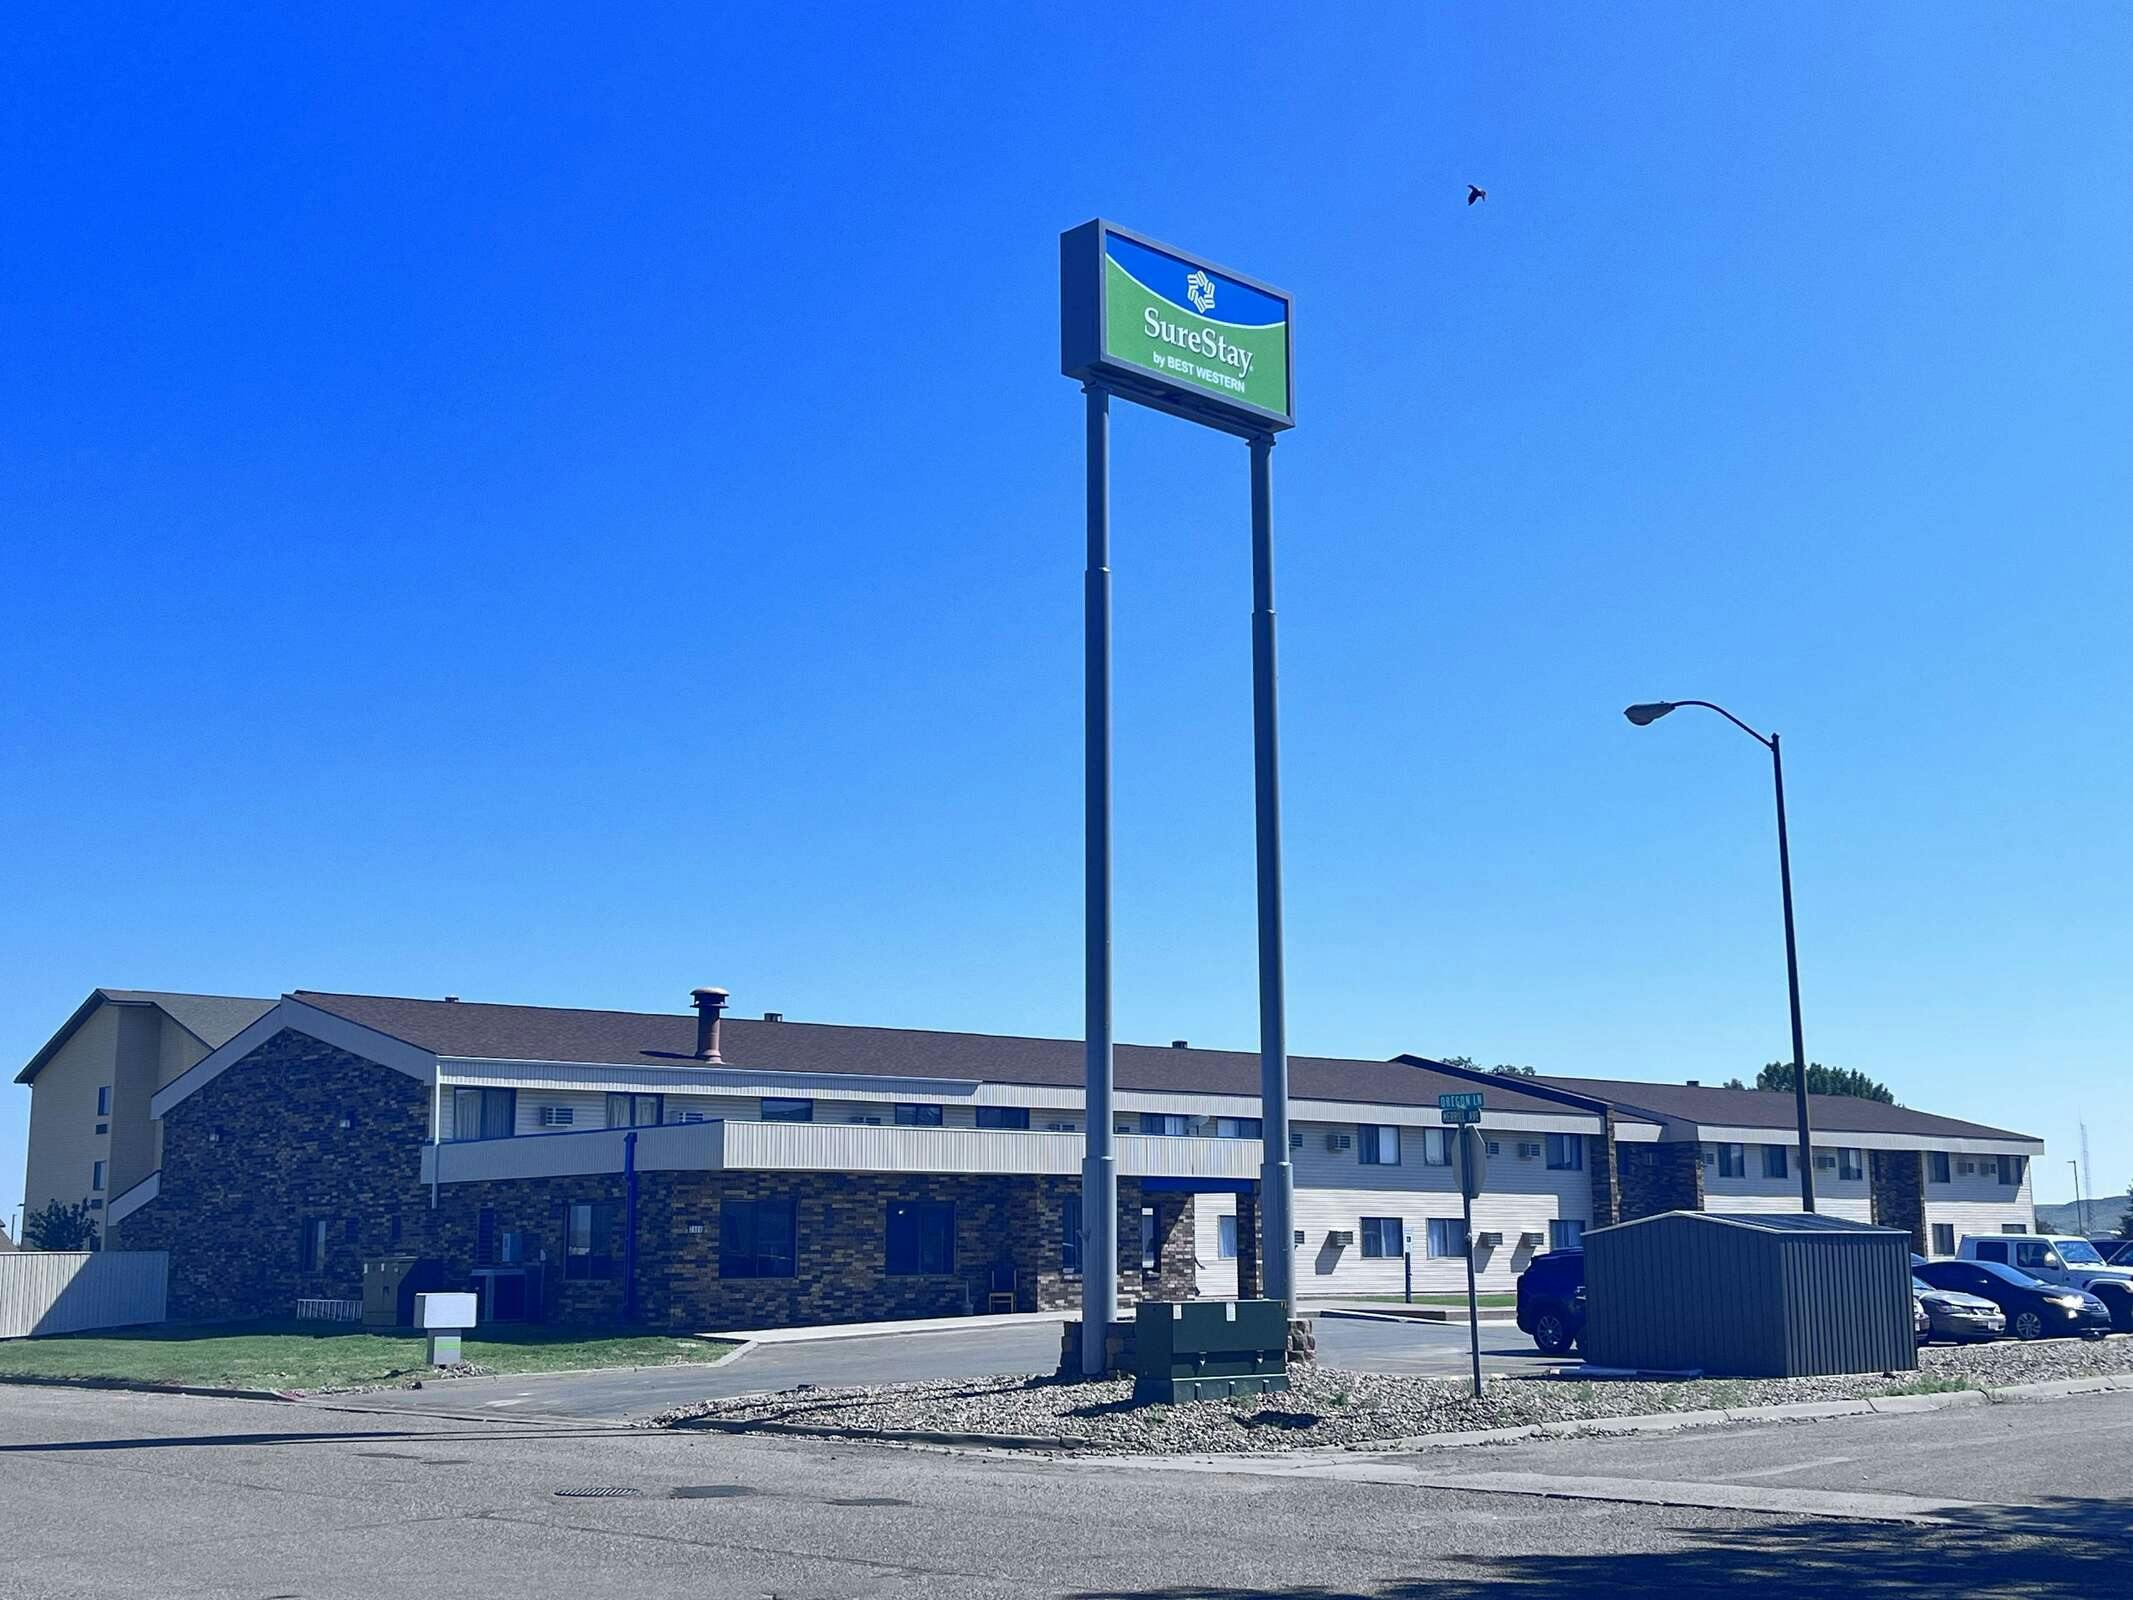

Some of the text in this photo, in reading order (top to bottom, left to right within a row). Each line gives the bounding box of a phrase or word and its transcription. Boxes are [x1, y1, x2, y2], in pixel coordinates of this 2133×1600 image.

[1144, 307, 1253, 378] SureStay
[1153, 351, 1245, 393] by BEST WESTERN
[1440, 1095, 1470, 1107] OREGON
